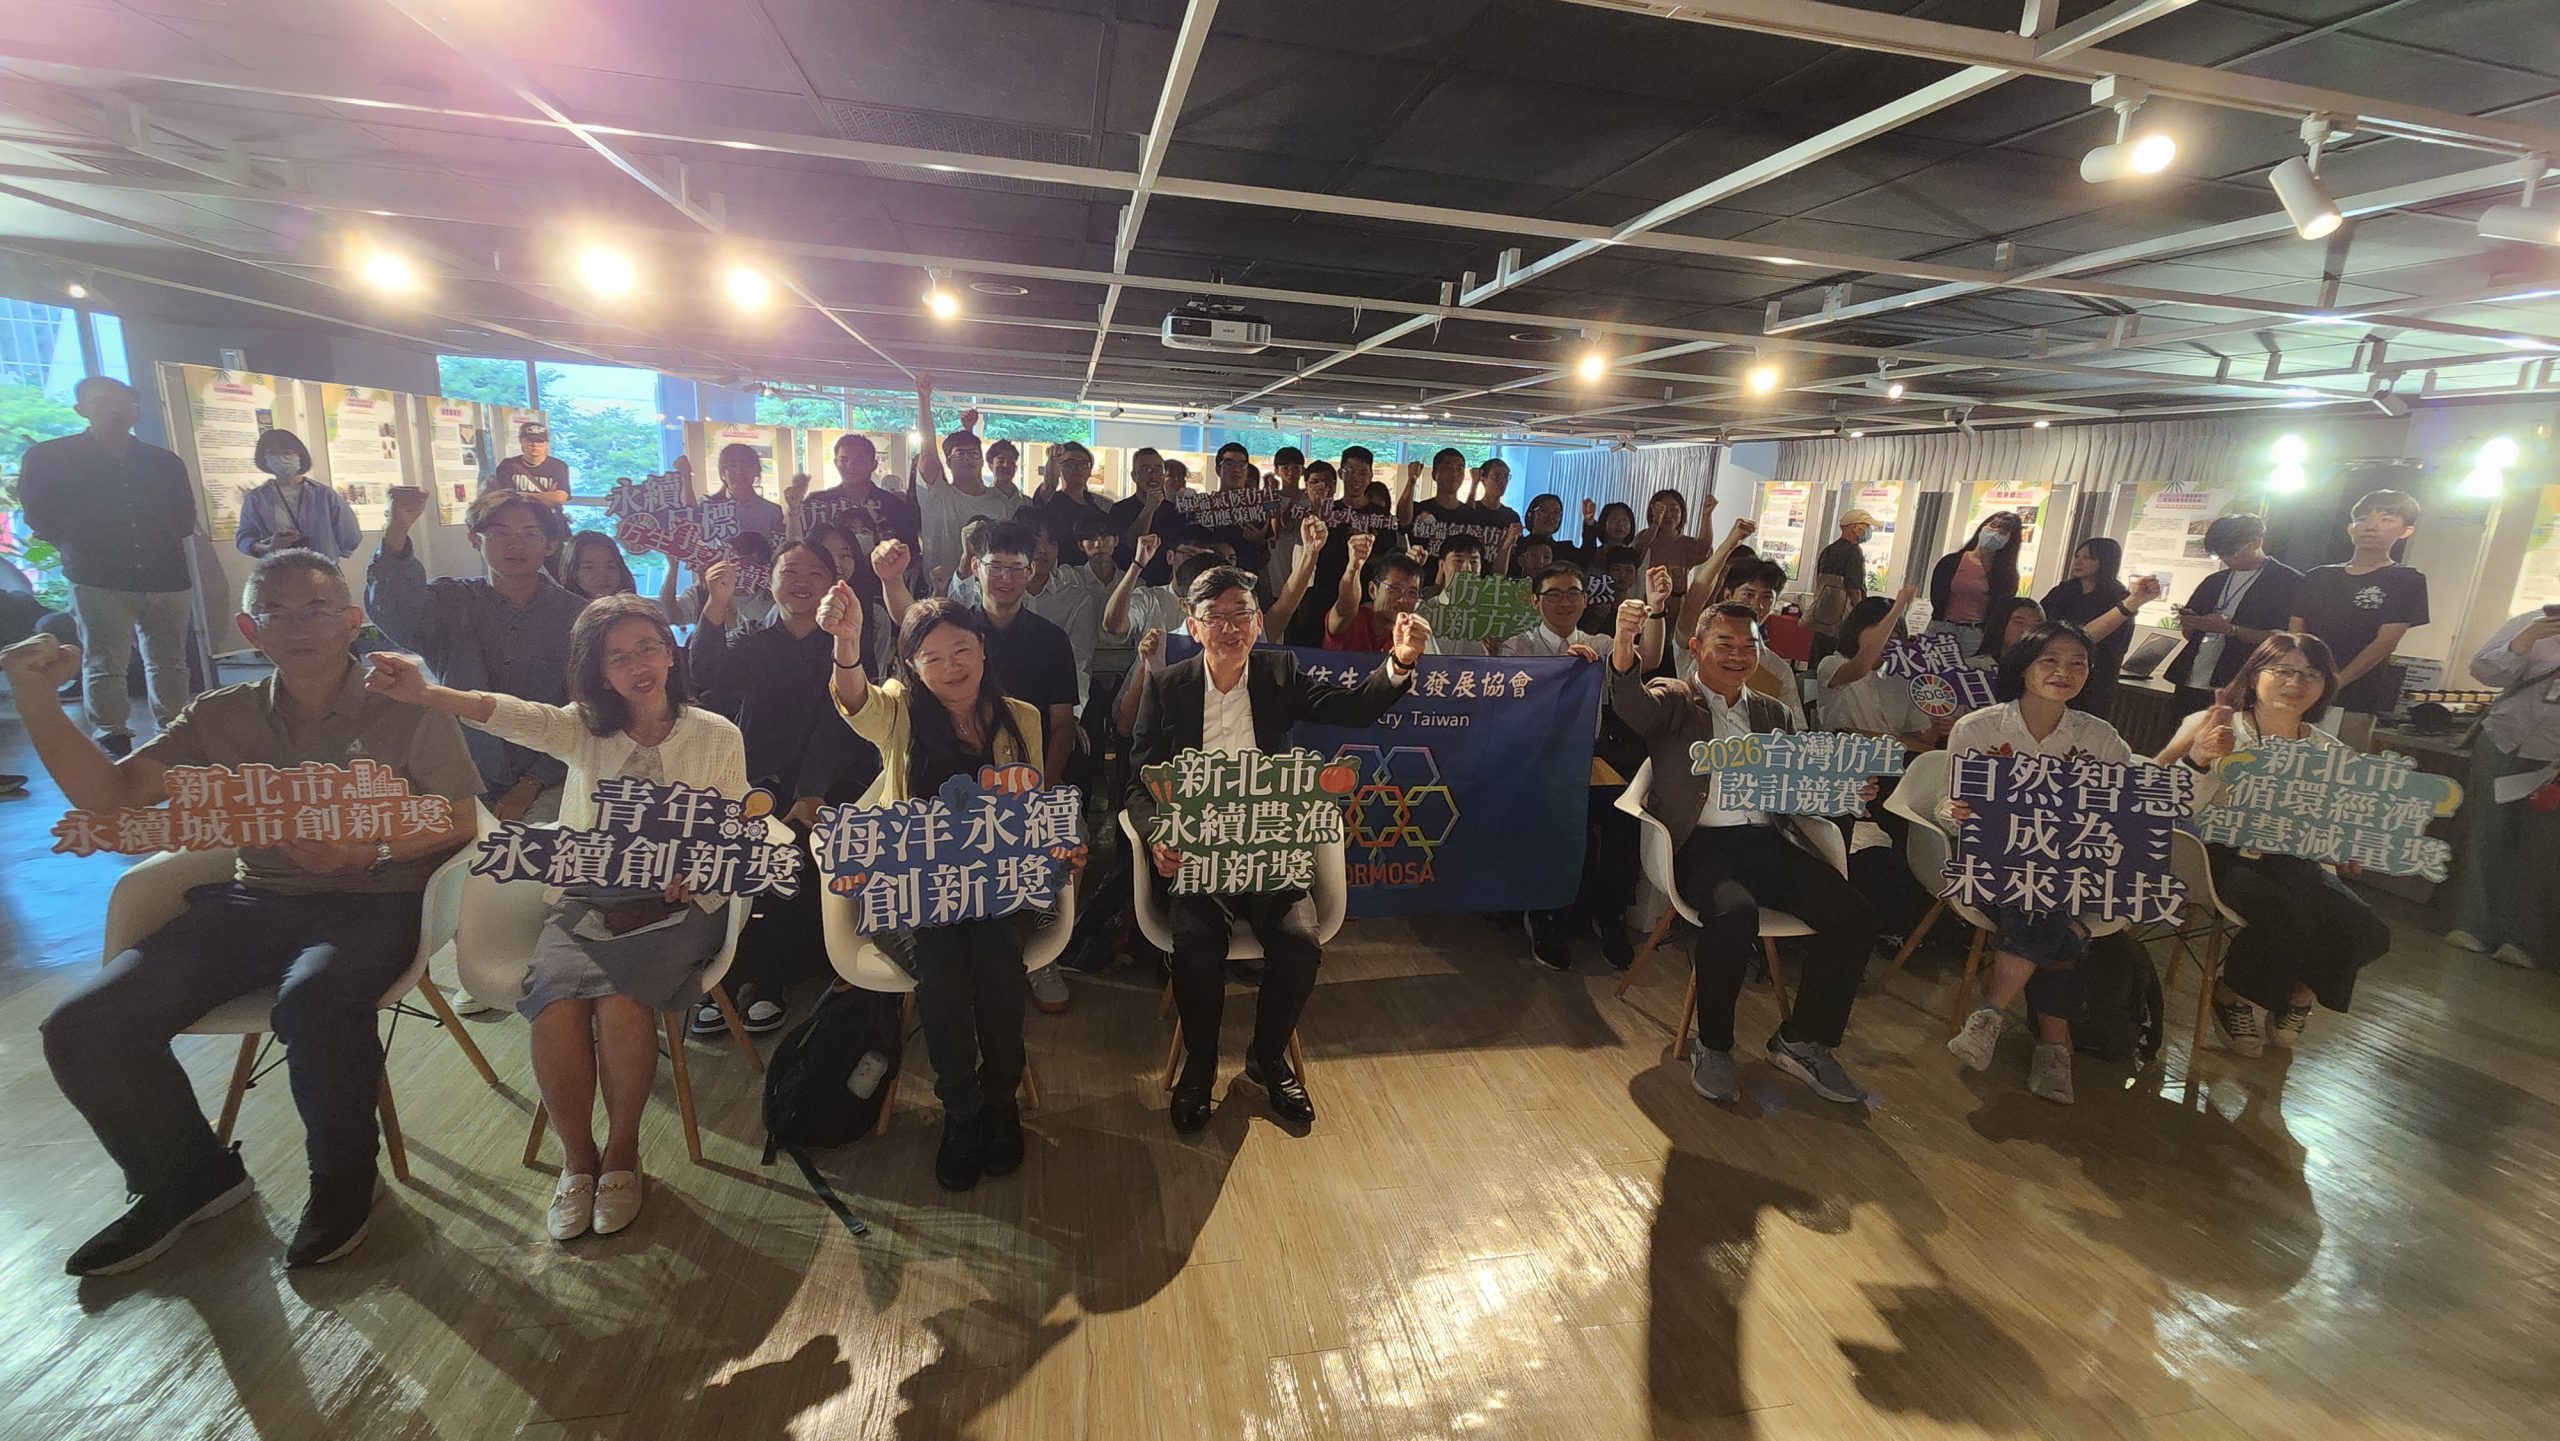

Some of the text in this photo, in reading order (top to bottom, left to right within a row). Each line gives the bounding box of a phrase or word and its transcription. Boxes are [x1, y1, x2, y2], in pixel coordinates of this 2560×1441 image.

[607, 474, 682, 516] 永續
[1446, 572, 1512, 607] 仿生
[1884, 634, 1969, 677] 永續
[1307, 664, 1534, 698] 仿生發展協會
[1915, 689, 1951, 701] SDGs
[1412, 710, 1470, 727] Taiwan
[1176, 750, 1322, 798] 新北市
[1694, 732, 1905, 774] 2026台灣仿生
[2261, 736, 2417, 792] 新北市
[171, 768, 333, 808] 新北市
[1720, 771, 1868, 816] 設計競賽
[1952, 751, 2195, 817] 自然智慧
[2227, 770, 2434, 835] 循環經濟
[54, 799, 450, 853] 永續城市創新獎
[594, 779, 720, 838] 青年
[816, 786, 1082, 871] 海洋永續
[1149, 799, 1341, 847] 永續農漁
[470, 825, 801, 897] 永續創新獎
[2003, 807, 2125, 867] 成為
[2200, 803, 2451, 883] 智慧減量獎
[857, 853, 1053, 932] 創新獎
[1171, 848, 1315, 894] 創新獎
[1938, 853, 2187, 927] 未來科技
